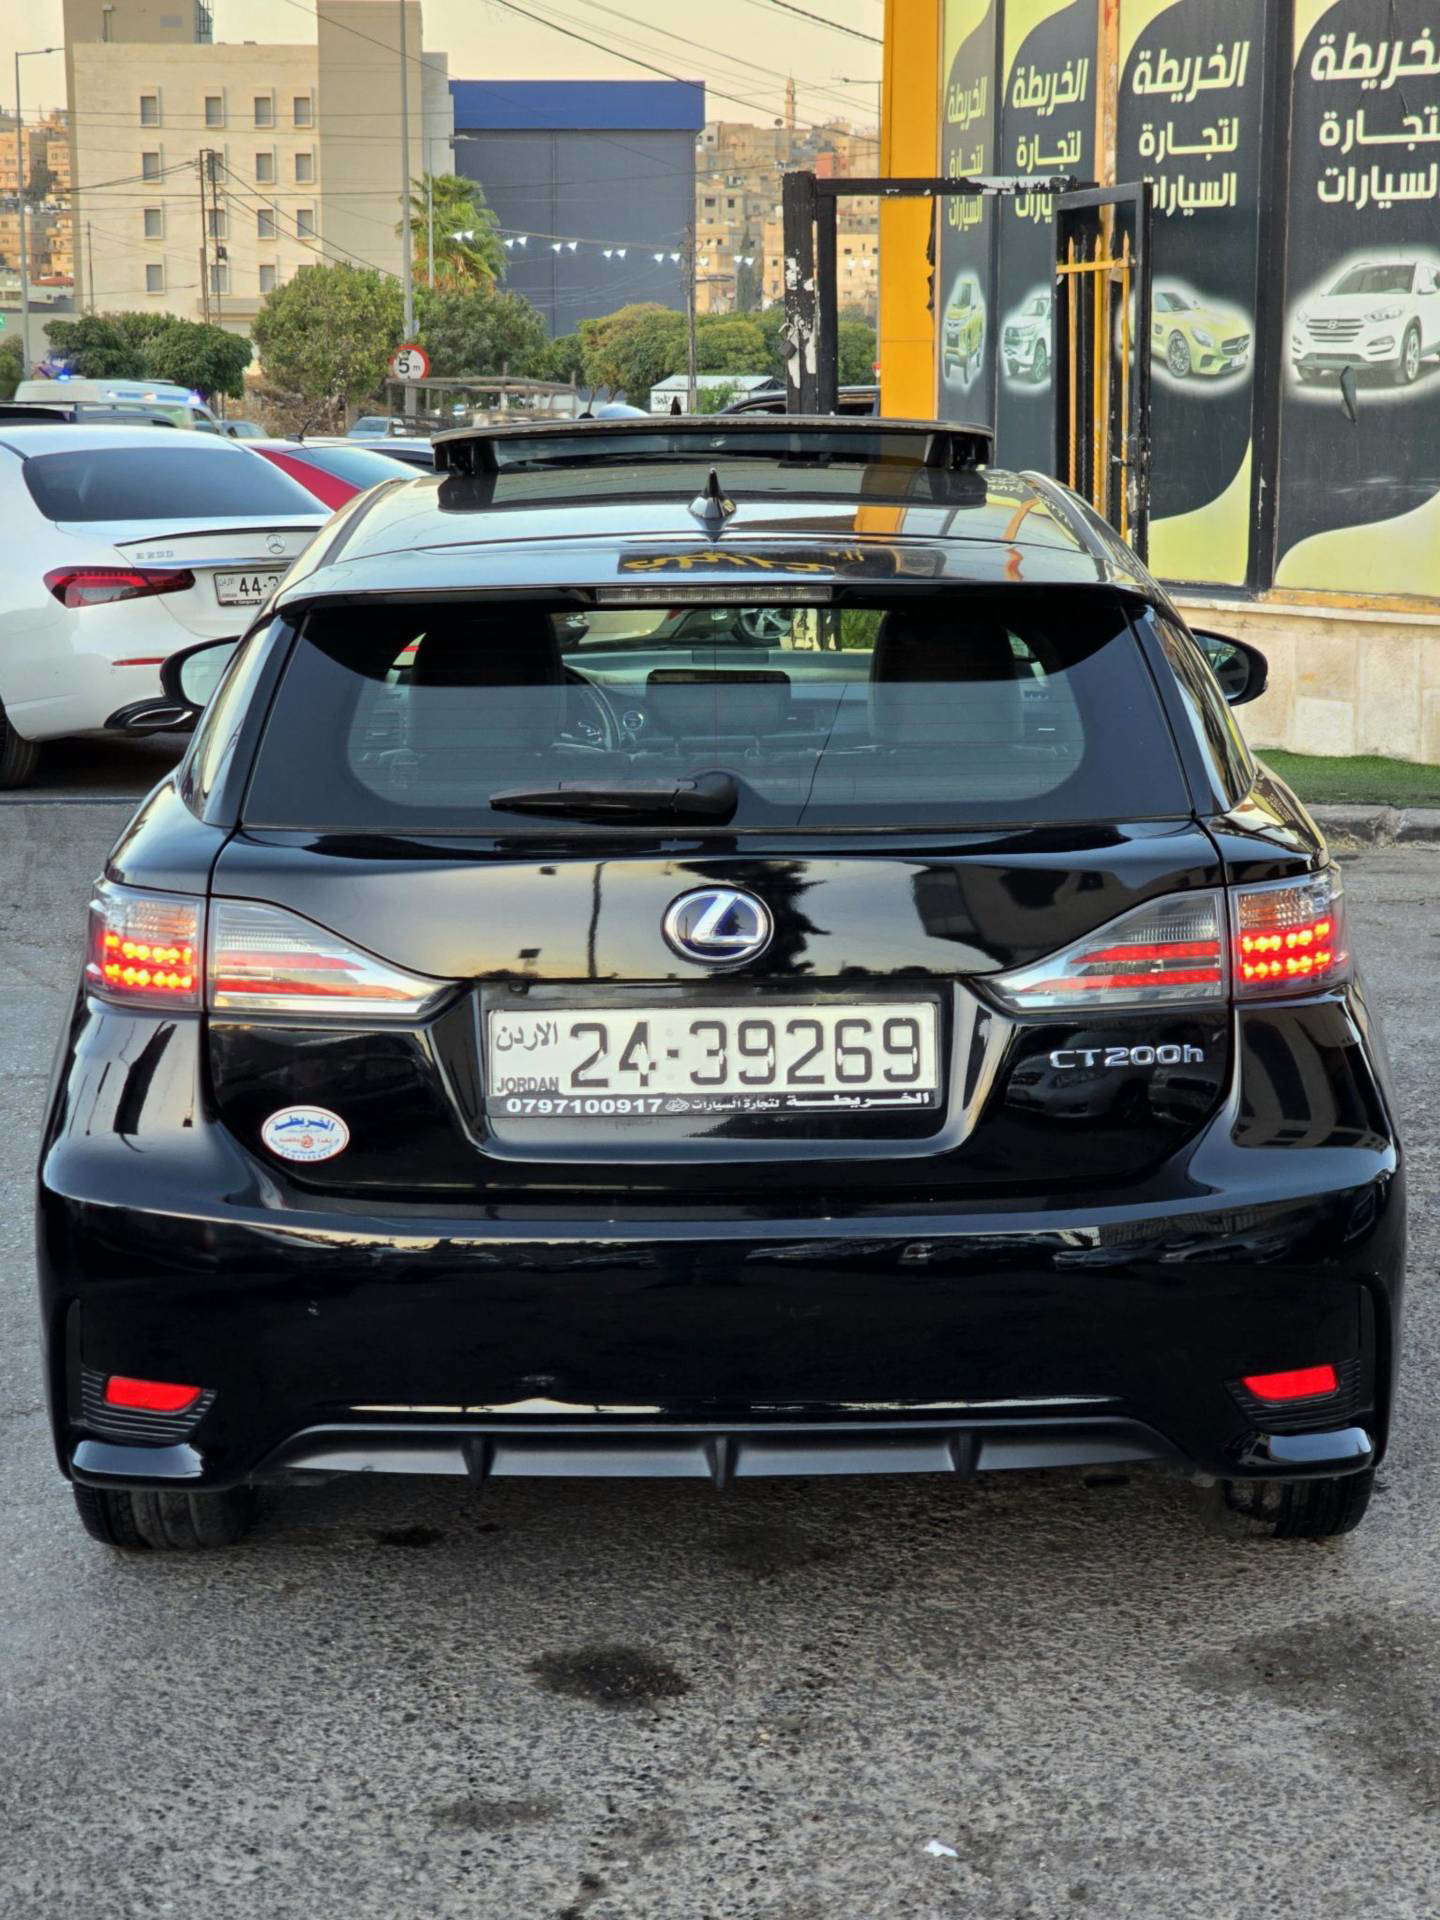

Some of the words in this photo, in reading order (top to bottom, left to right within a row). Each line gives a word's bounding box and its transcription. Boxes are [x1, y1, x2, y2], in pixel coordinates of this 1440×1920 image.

[1132, 41, 1250, 102] الخريطة
[1311, 28, 1440, 90] خريطة
[948, 76, 988, 130] الخريطة
[1012, 58, 1089, 116] الخريطة
[1016, 130, 1082, 173] لتجارة
[1139, 117, 1239, 164] لتجارة
[1319, 106, 1440, 154] تجارة
[1317, 163, 1440, 210] لسيارات
[399, 358, 410, 374] 5
[496, 1021, 559, 1051] الاردن
[496, 1077, 560, 1094] JORDAN
[506, 1098, 664, 1115] 0797100917
[691, 1099, 742, 1112] السيارات
[743, 1098, 780, 1111] لتجارة
